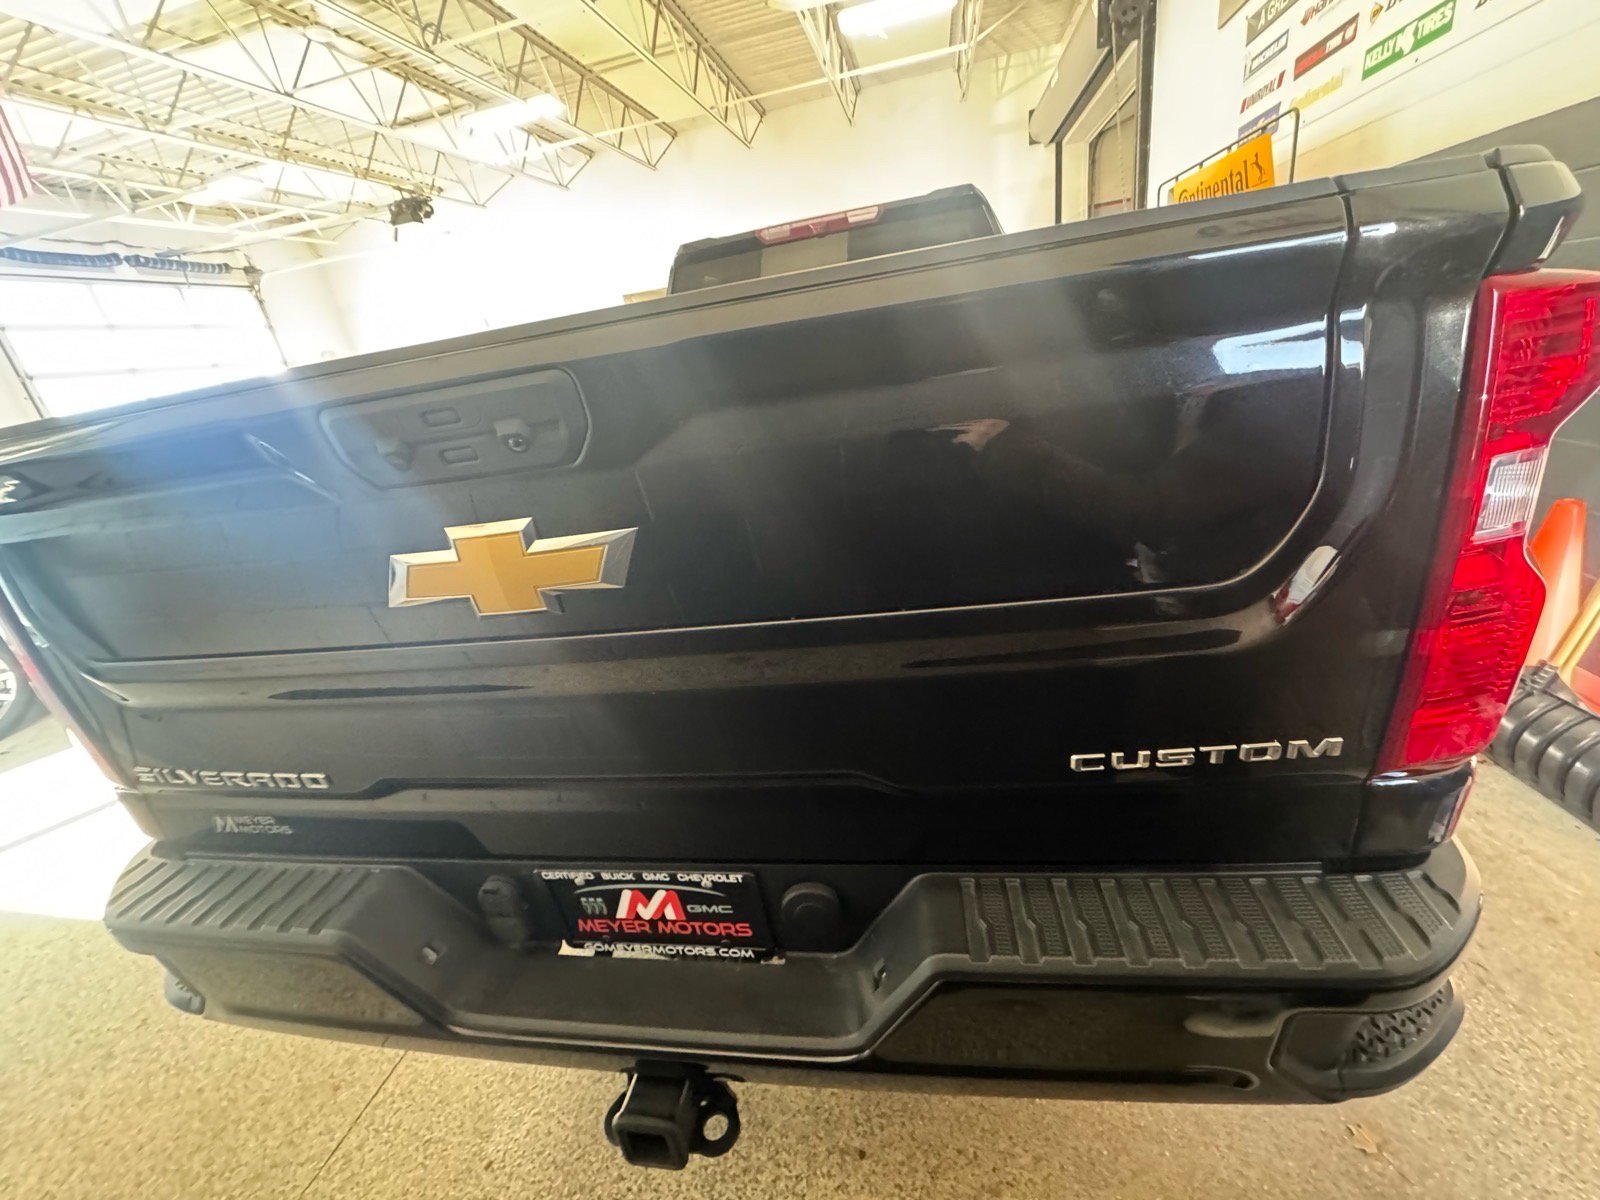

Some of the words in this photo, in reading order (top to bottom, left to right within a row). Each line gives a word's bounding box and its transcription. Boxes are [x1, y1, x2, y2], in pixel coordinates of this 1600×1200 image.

[1364, 34, 1397, 71] KELLY
[1416, 2, 1454, 41] TIRES
[1069, 736, 1345, 772] CUSTOM
[132, 766, 331, 790] SILVERADO
[541, 871, 595, 882] CERTIFIED
[600, 872, 636, 882] BUICK
[641, 873, 671, 883] GMC
[676, 873, 744, 885] CHEVROLET
[686, 904, 734, 914] GMC
[577, 918, 652, 935] MEYER
[657, 920, 754, 938] MOTORS
[583, 941, 756, 960] GOMEYERMOTORS.COM
